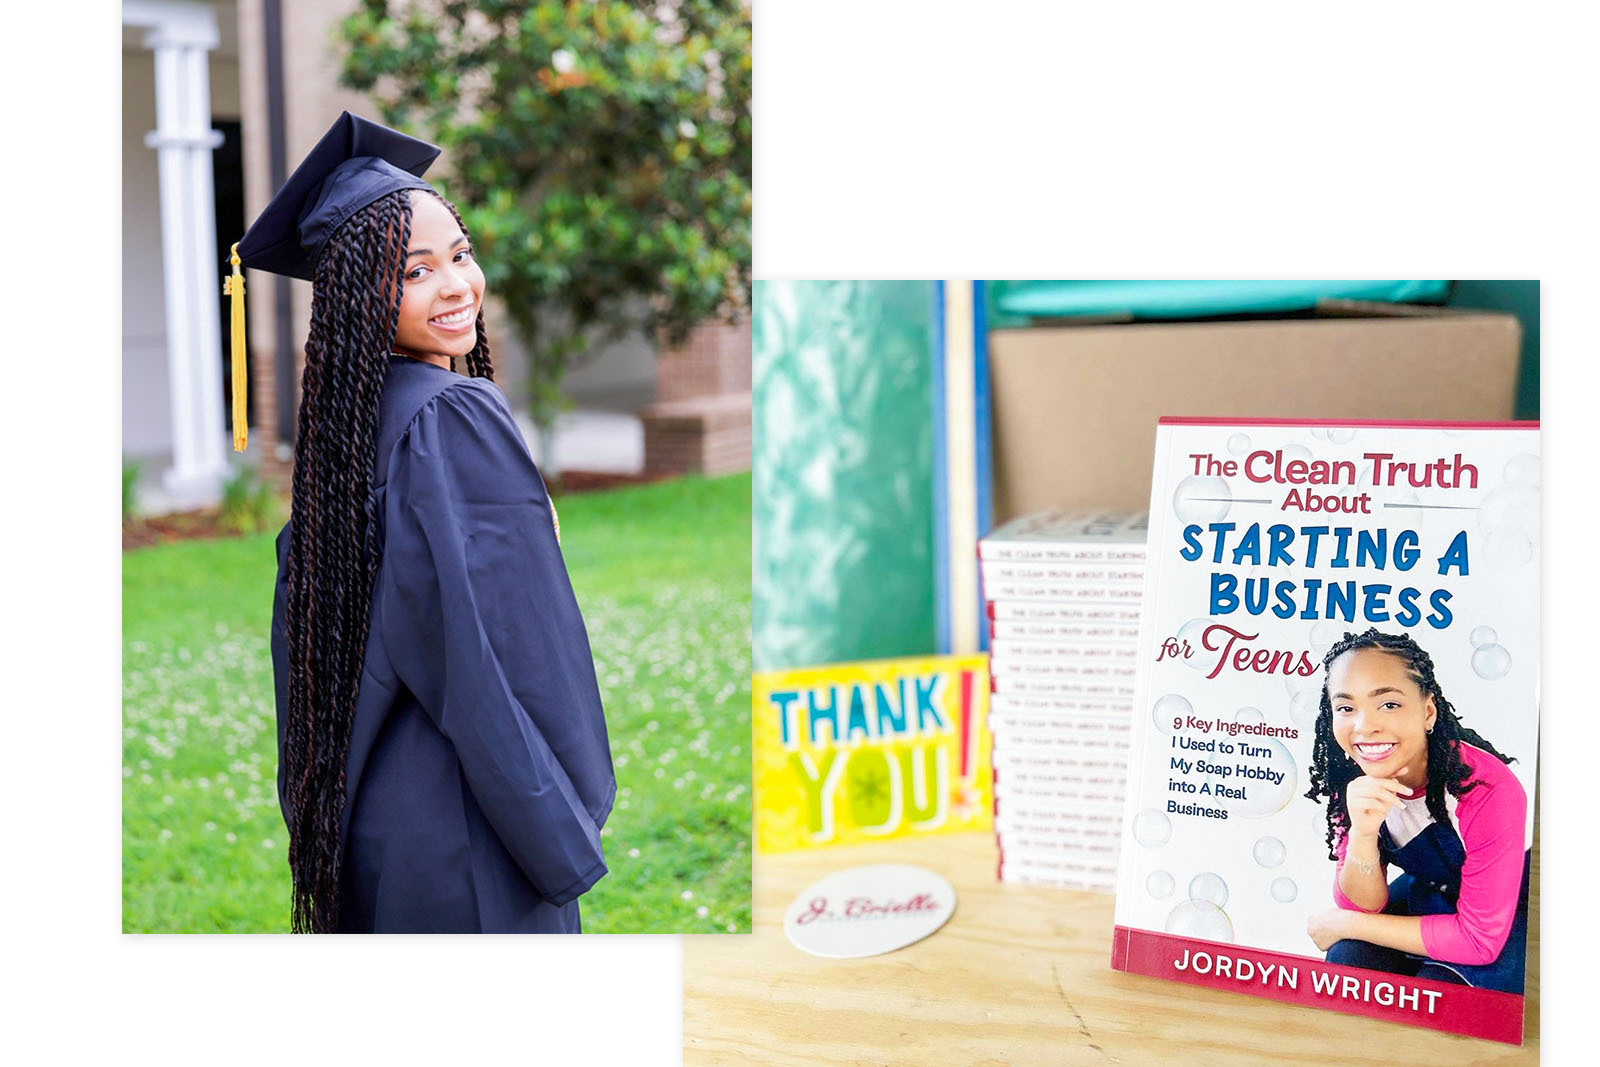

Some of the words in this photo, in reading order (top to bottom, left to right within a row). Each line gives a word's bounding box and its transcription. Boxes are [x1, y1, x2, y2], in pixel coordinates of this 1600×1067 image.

[1189, 454, 1238, 477] The
[1245, 450, 1356, 486] Clean
[1363, 453, 1479, 488] Truth
[1281, 488, 1371, 514] About
[1180, 522, 1421, 571] STARTING
[1438, 530, 1470, 576] A
[1209, 573, 1453, 629] BUSINESS
[1156, 637, 1194, 662] for
[1202, 624, 1322, 680] Teens
[770, 673, 947, 744] THANK
[1173, 717, 1183, 730] 9
[1186, 716, 1213, 733] Key
[1216, 719, 1299, 739] Ingredients
[1171, 736, 1176, 748] I
[1179, 737, 1215, 752] Used
[1219, 742, 1234, 754] to
[1238, 743, 1272, 758] Turn
[788, 744, 942, 836] YOU
[1168, 778, 1196, 793] into
[1200, 783, 1211, 795] A
[1215, 784, 1247, 800] Real
[1170, 757, 1193, 774] My
[1196, 760, 1232, 778] Soap
[1236, 764, 1285, 785] Hobby
[1167, 800, 1228, 820] Business
[1174, 949, 1299, 990] JORDYN
[1311, 970, 1443, 1014] WRIGHT
